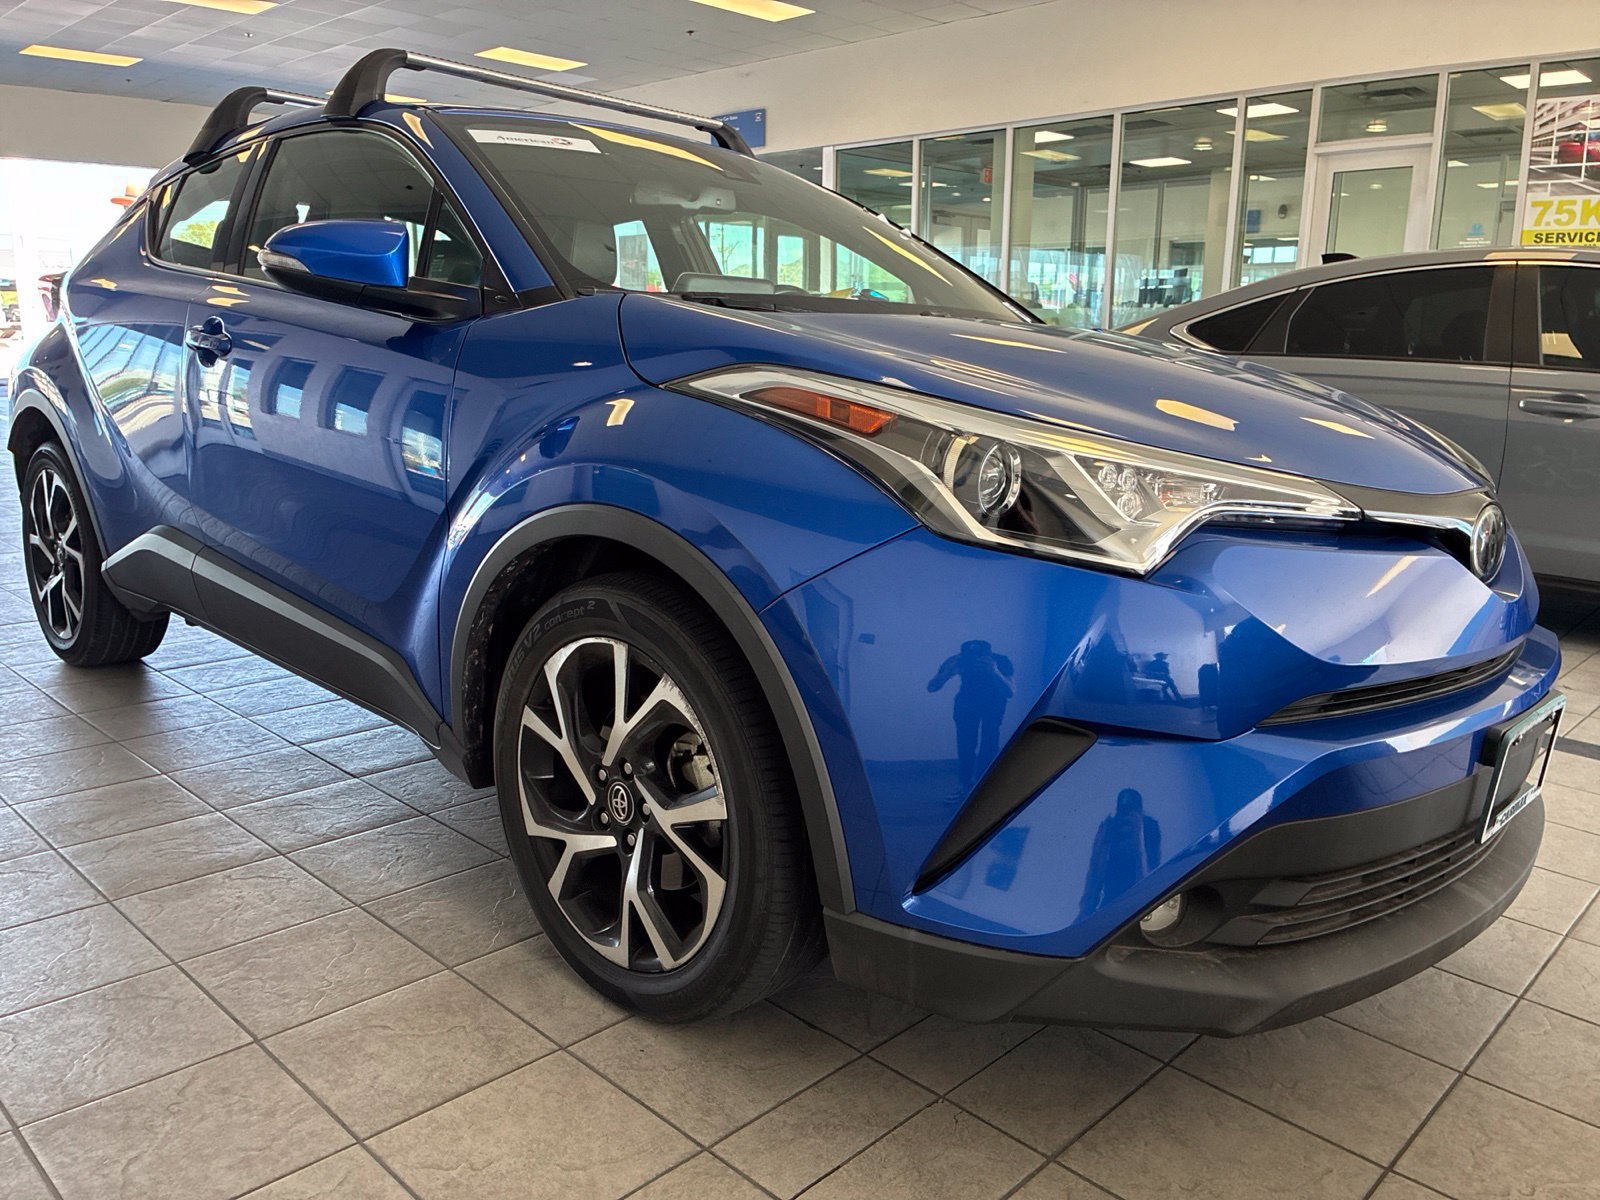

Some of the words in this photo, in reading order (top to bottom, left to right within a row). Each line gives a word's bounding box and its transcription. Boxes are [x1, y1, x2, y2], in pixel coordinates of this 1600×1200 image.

[523, 624, 541, 648] V2
[544, 606, 584, 631] concept
[586, 600, 596, 610] 2
